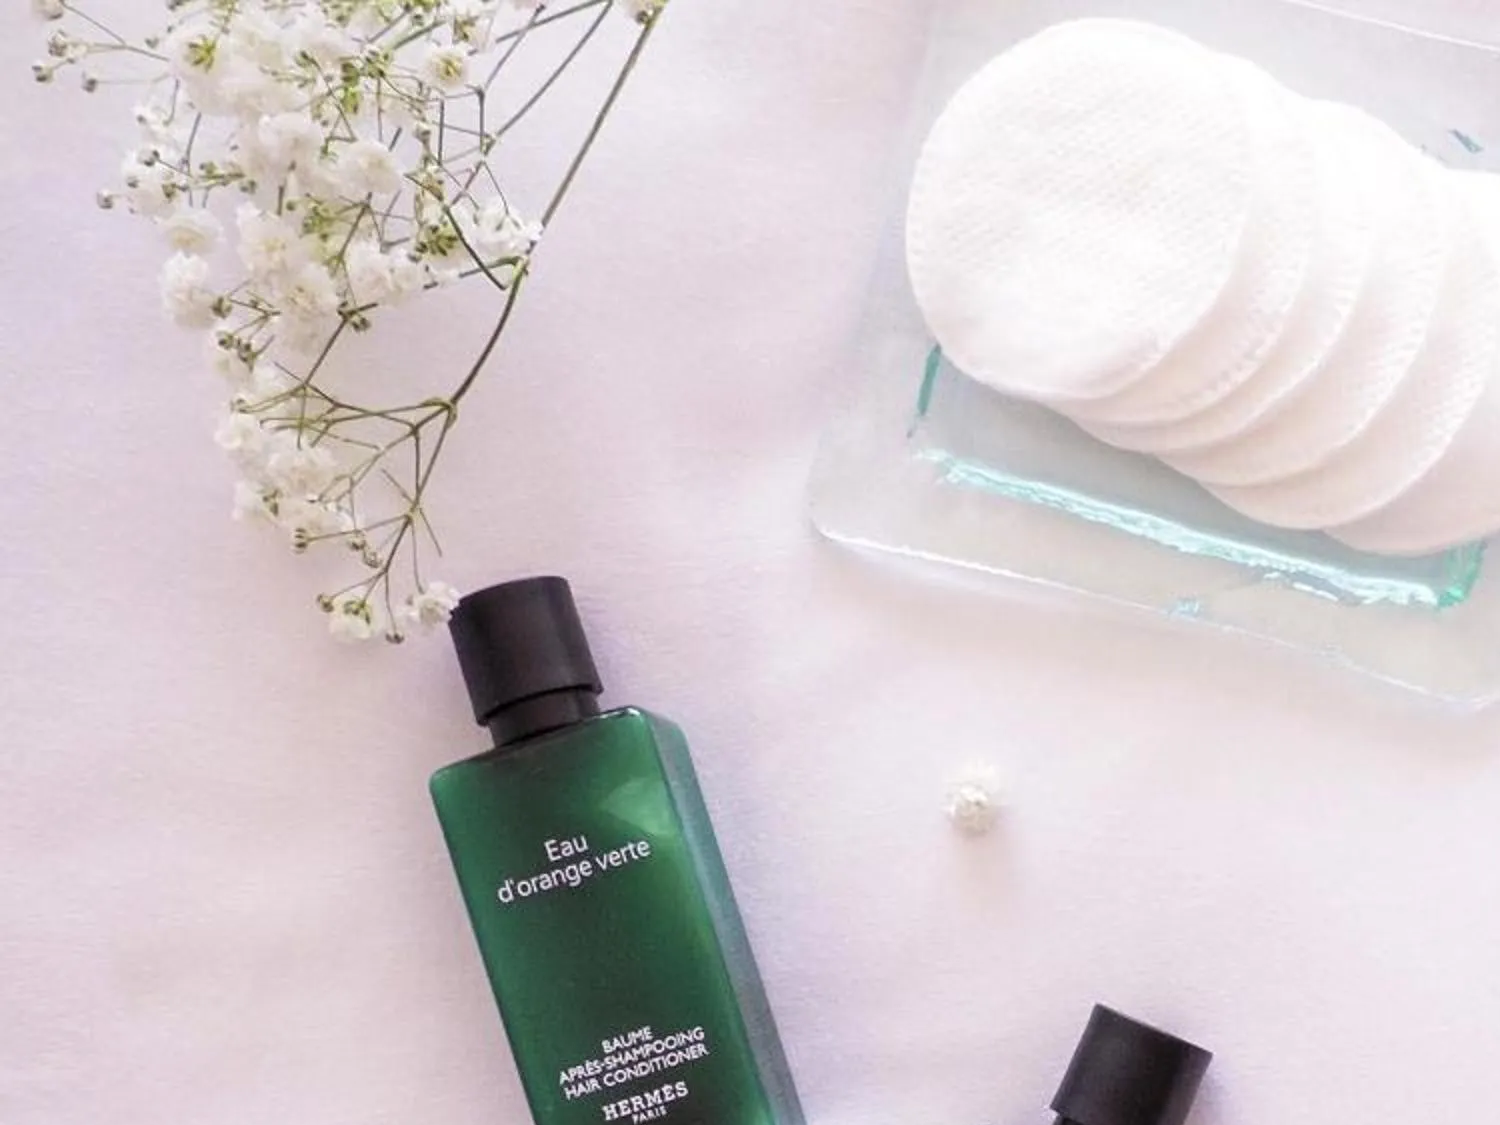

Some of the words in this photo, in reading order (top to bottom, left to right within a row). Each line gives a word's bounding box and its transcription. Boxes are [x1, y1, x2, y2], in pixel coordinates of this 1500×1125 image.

[544, 834, 589, 861] Eau
[497, 860, 592, 903] d'orange
[595, 840, 651, 871] verte
[559, 1026, 705, 1085] APRÈS-SHAMPOOING
[601, 1025, 654, 1053] BAUME
[564, 1078, 602, 1100] HAIR
[603, 1043, 710, 1087] CONDITIONER
[602, 1080, 689, 1121] HERMÈS
[632, 1106, 667, 1125] PARIS
